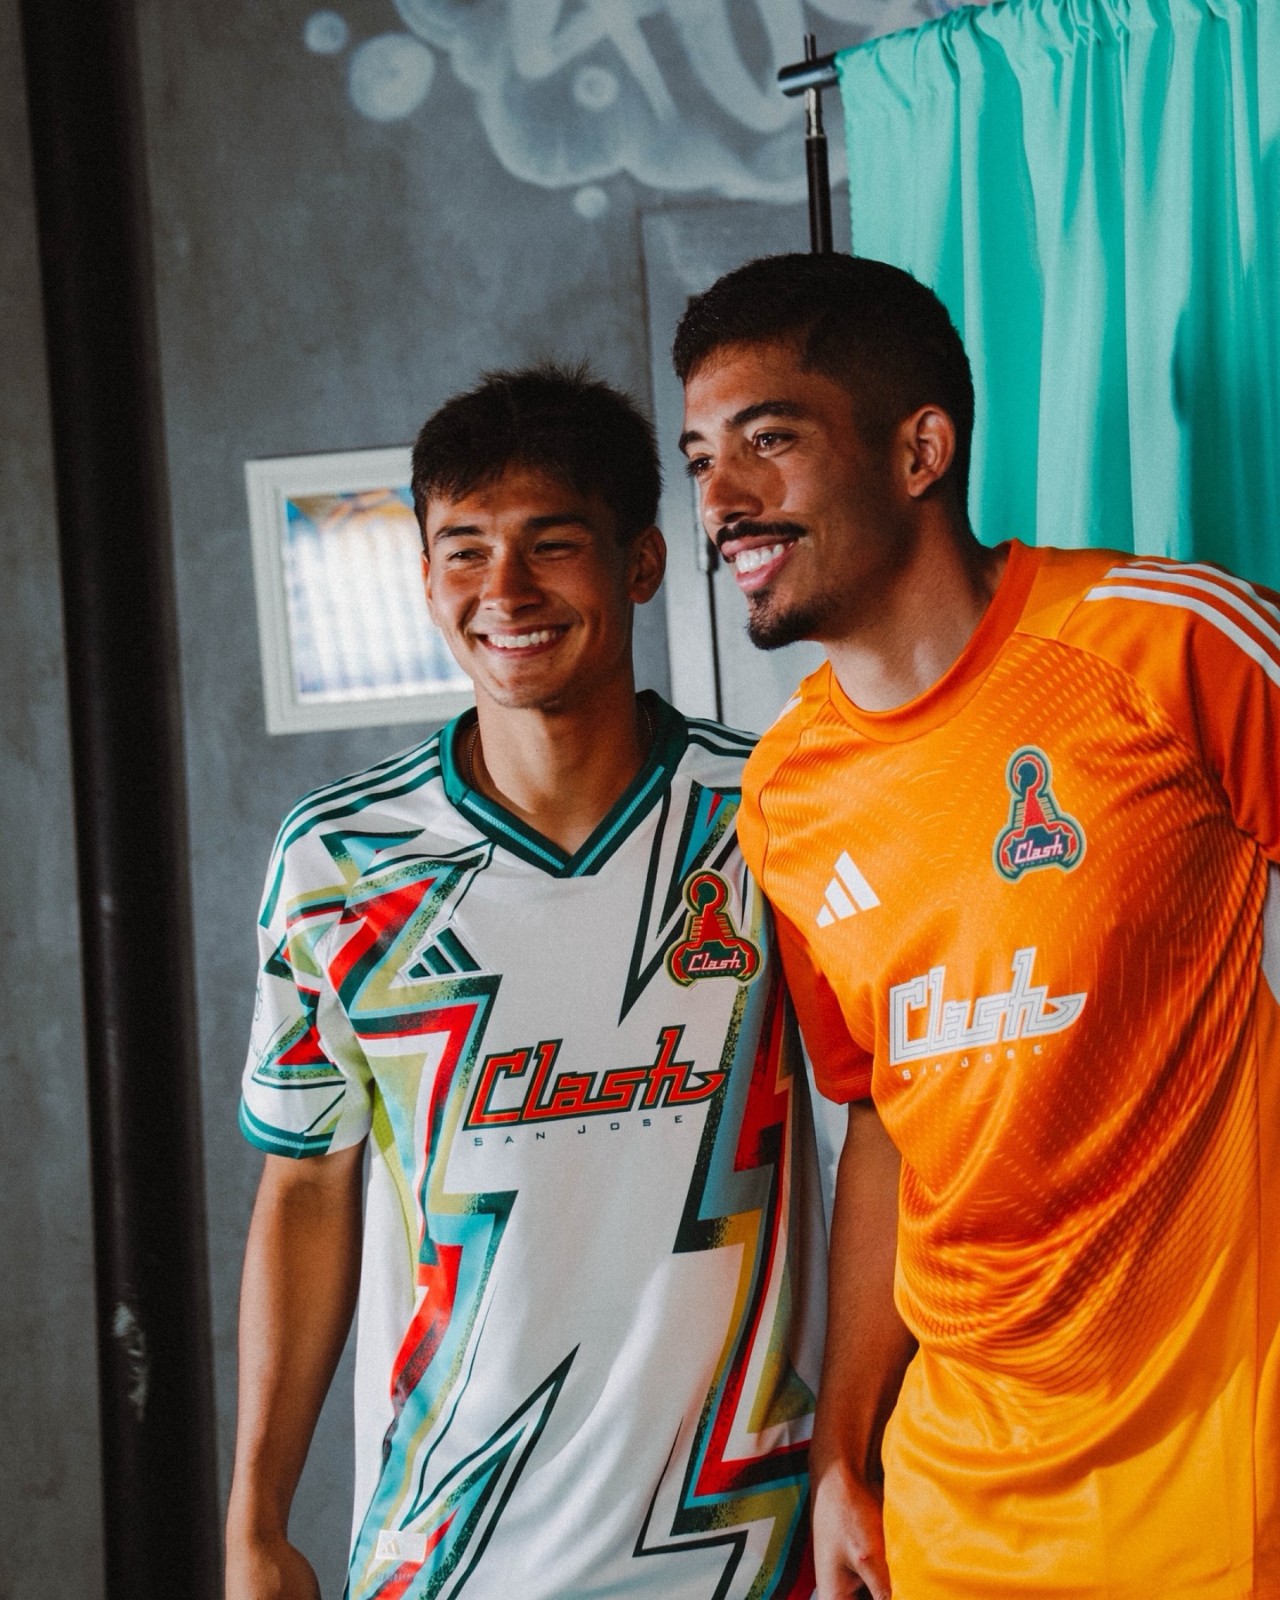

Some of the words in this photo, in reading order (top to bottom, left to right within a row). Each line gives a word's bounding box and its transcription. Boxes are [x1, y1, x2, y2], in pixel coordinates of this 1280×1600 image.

[1014, 834, 1064, 864] Clash
[687, 951, 741, 971] Clash
[889, 946, 1088, 1066] Clash
[961, 1045, 1042, 1068] JOSE
[462, 1024, 730, 1131] Clash
[474, 1132, 545, 1146] SAN
[578, 1115, 682, 1134] JOSE
